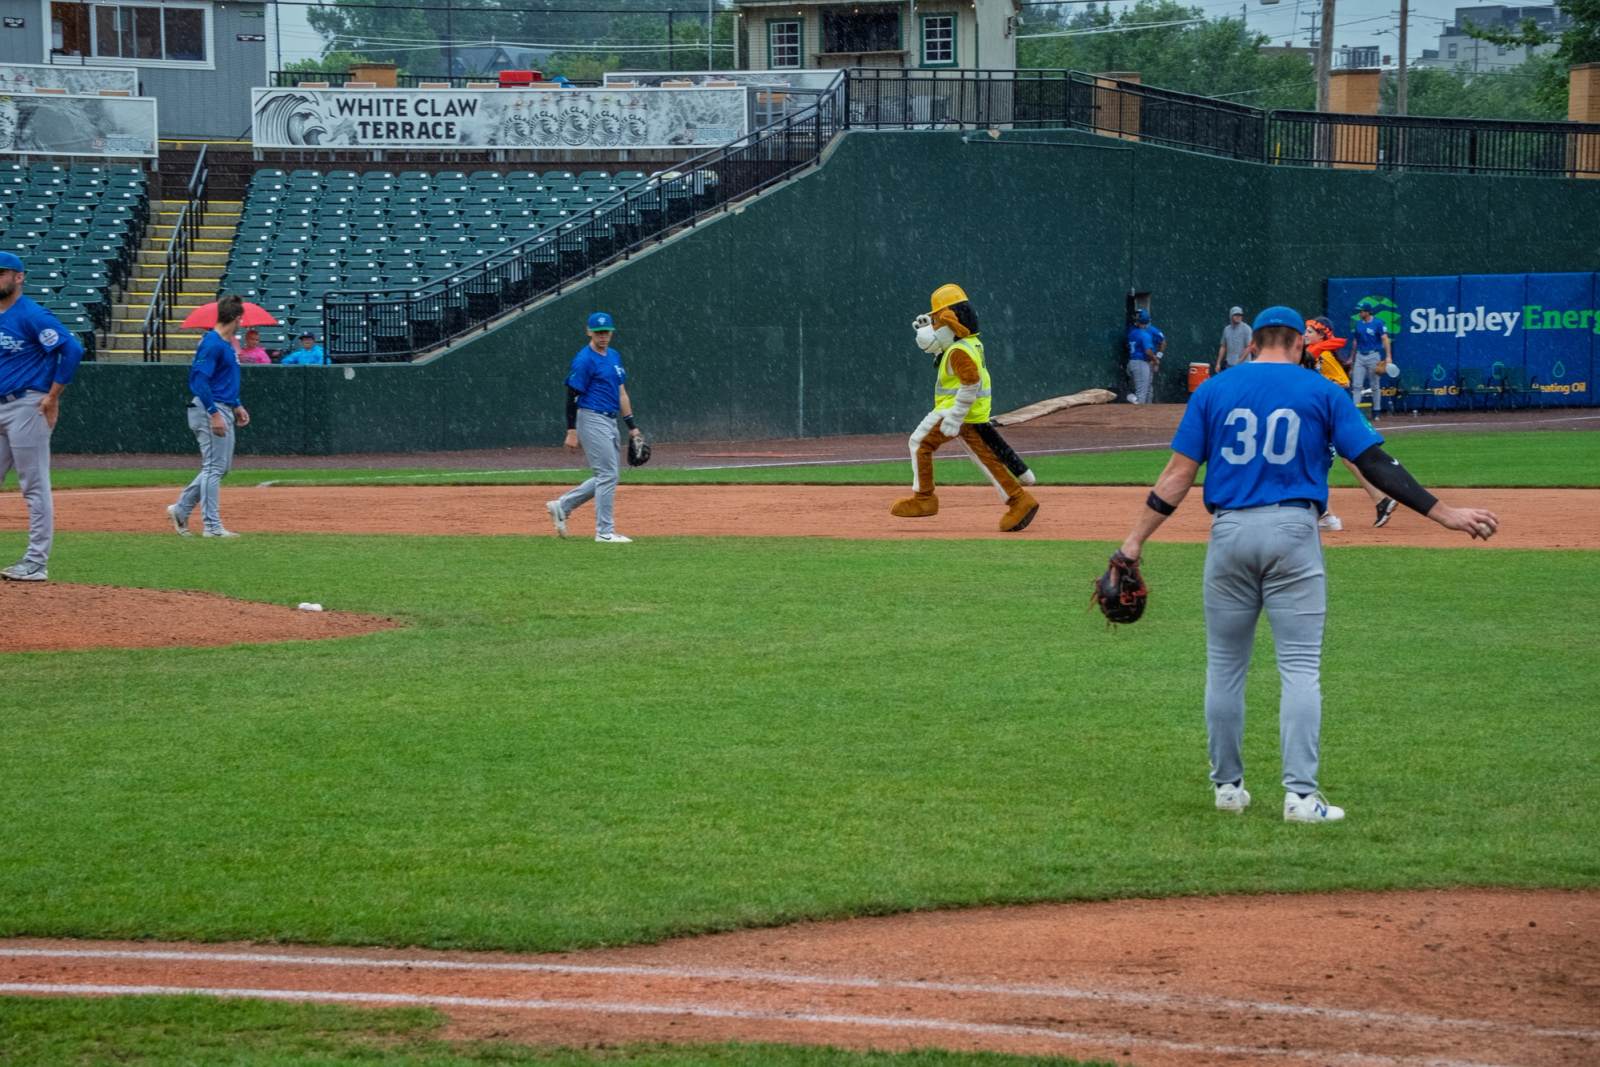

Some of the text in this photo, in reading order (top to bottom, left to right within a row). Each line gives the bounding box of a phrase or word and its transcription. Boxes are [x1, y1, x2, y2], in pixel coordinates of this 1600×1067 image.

[336, 98, 478, 117] WHITE CLAW
[357, 121, 456, 139] TERRACE
[1410, 305, 1520, 337] Shipley
[1571, 382, 1586, 393] Oil
[1221, 408, 1301, 465] 30
